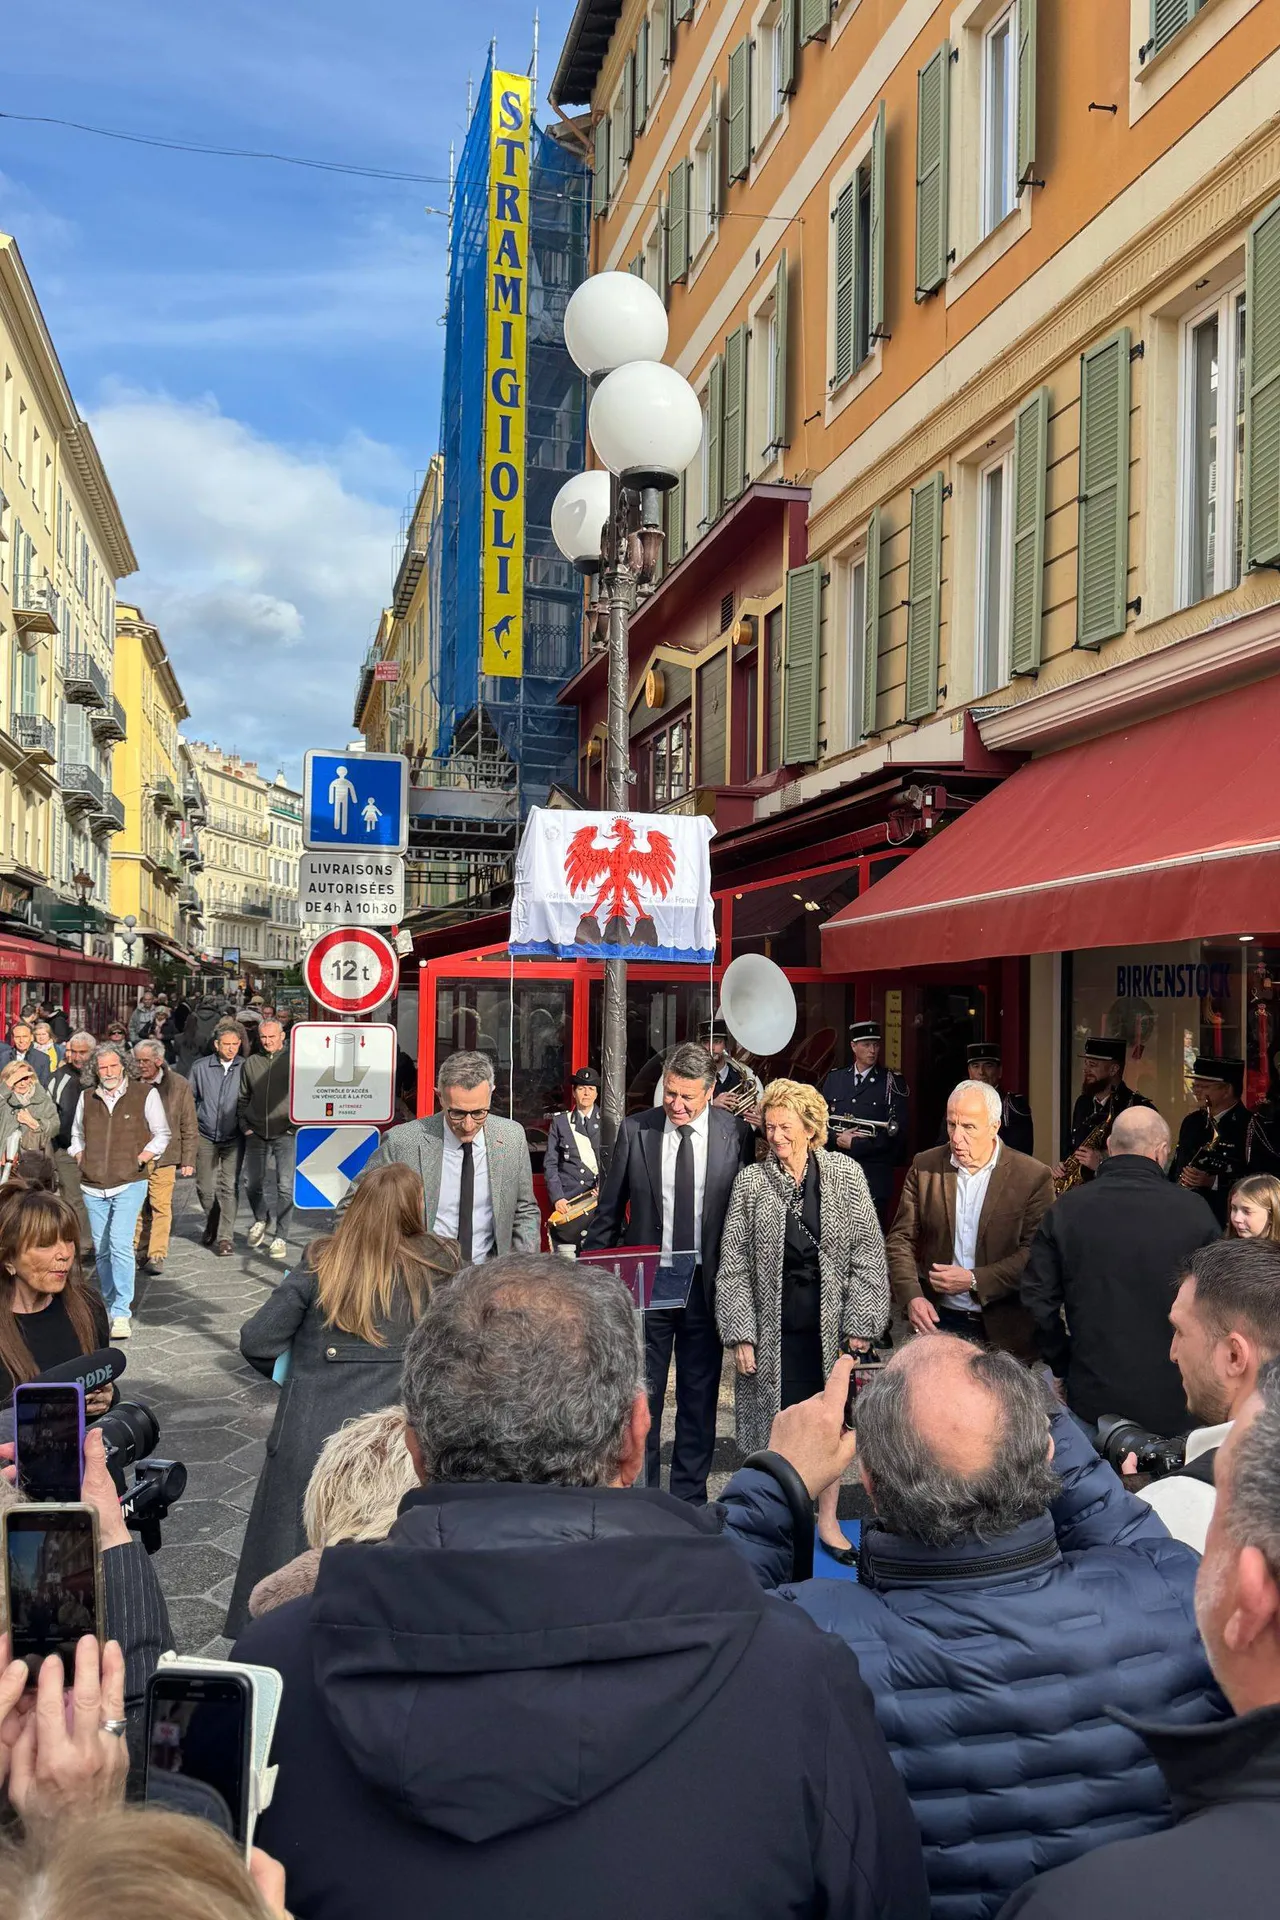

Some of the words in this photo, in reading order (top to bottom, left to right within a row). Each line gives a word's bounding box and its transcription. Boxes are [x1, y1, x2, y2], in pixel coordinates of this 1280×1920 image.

[490, 90, 525, 595] STRAMIGIOLI
[310, 863, 392, 875] LIVRAISONS
[309, 882, 394, 894] AUTORISÉES
[305, 902, 322, 912] DE
[345, 900, 352, 913] À
[675, 896, 695, 904] France
[332, 960, 358, 981] 12
[362, 966, 370, 981] t
[1116, 963, 1231, 998] BIRKENSTOCK
